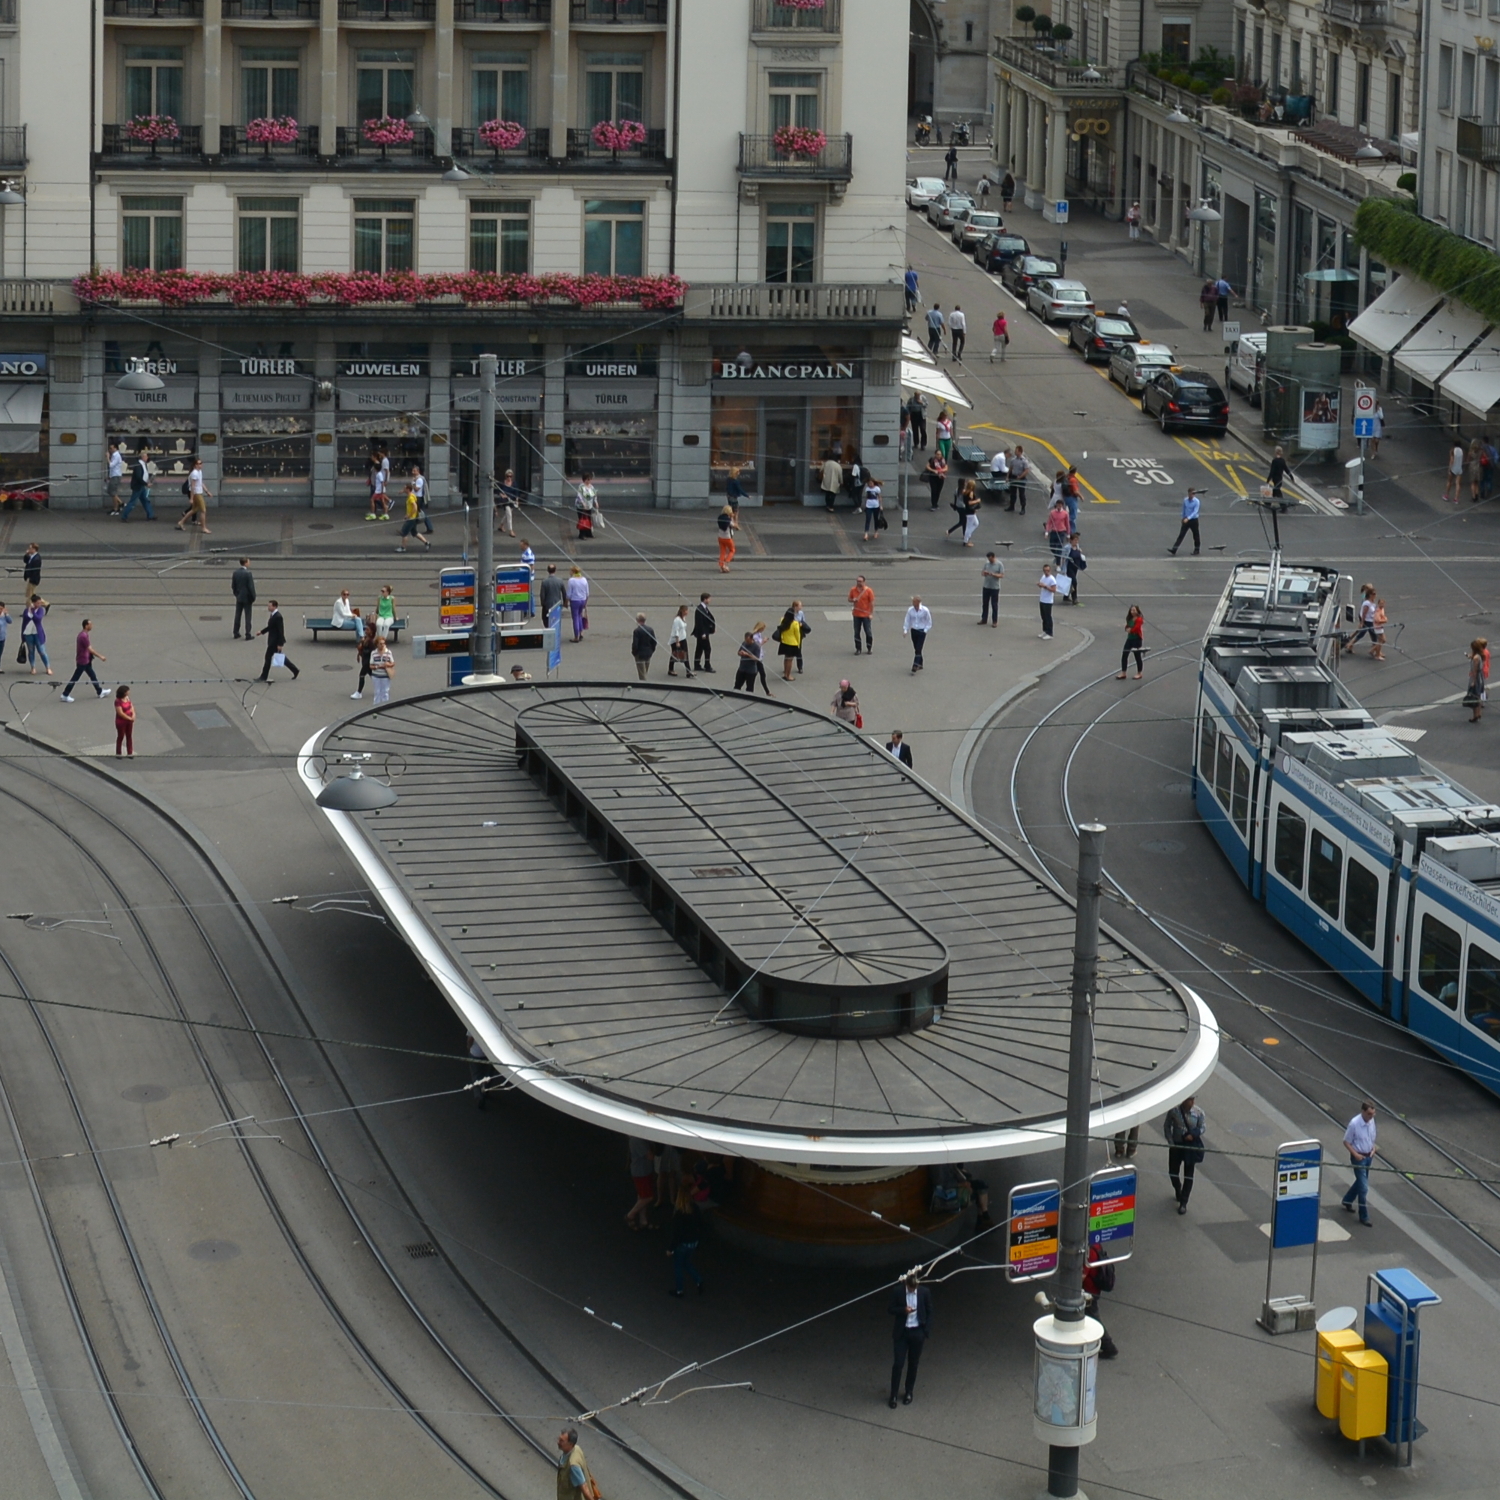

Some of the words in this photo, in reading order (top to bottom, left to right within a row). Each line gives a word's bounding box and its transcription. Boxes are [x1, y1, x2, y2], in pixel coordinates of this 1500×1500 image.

[239, 357, 295, 375] TÜRLER
[346, 363, 420, 376] JUWELEN
[586, 364, 638, 376] UHREN
[720, 362, 855, 379] BLANCPAIN
[134, 391, 168, 403] TÜRLER
[358, 394, 408, 405] BREGUET
[595, 393, 628, 404] TÜRLER
[1195, 450, 1256, 463] TAXI
[1107, 457, 1164, 469] ZONE
[1126, 469, 1175, 485] 30
[1092, 1189, 1123, 1201] Paradeplatz
[1013, 1250, 1022, 1259] 13
